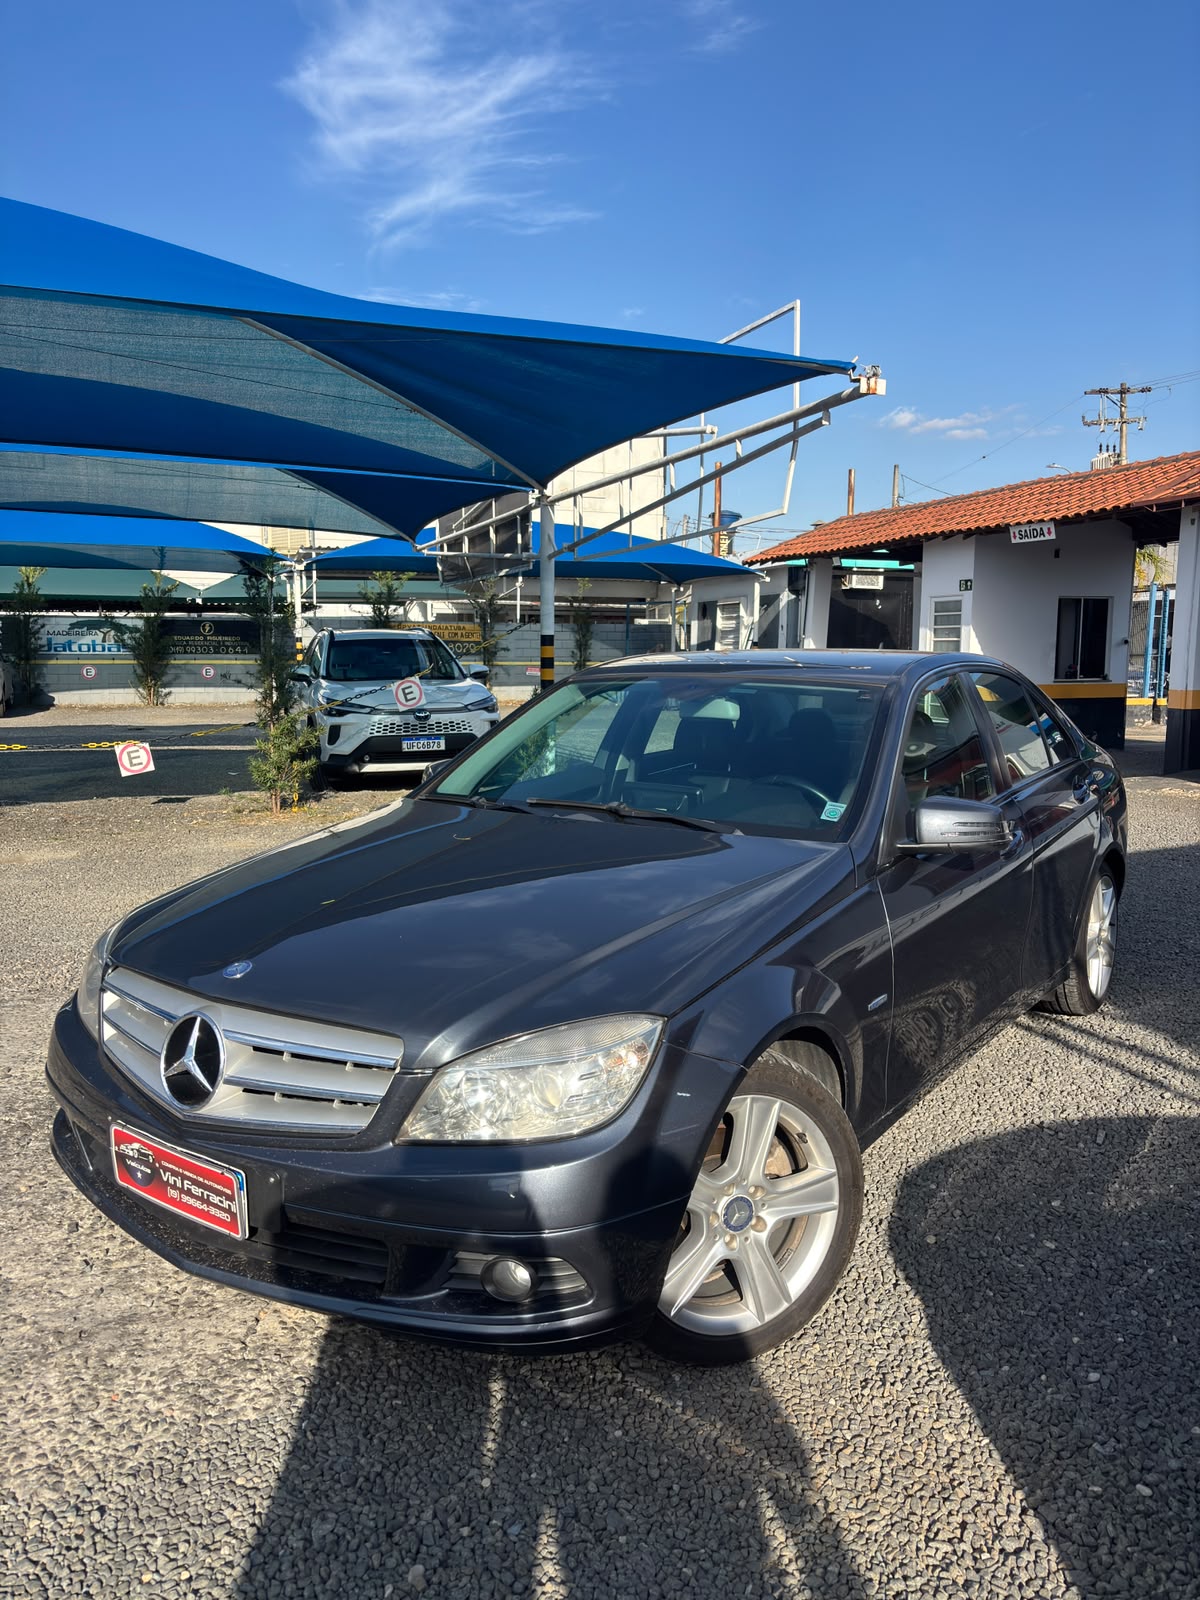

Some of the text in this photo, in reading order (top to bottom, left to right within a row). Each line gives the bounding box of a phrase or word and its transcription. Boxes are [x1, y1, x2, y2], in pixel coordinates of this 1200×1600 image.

[1017, 526, 1046, 540] SAÍDA
[85, 668, 93, 676] E
[204, 668, 212, 676] E
[401, 686, 417, 704] E
[406, 741, 441, 750] UFC6B78
[127, 749, 143, 768] E
[159, 1169, 237, 1213] Vini Ferracini
[167, 1186, 180, 1201] (19)
